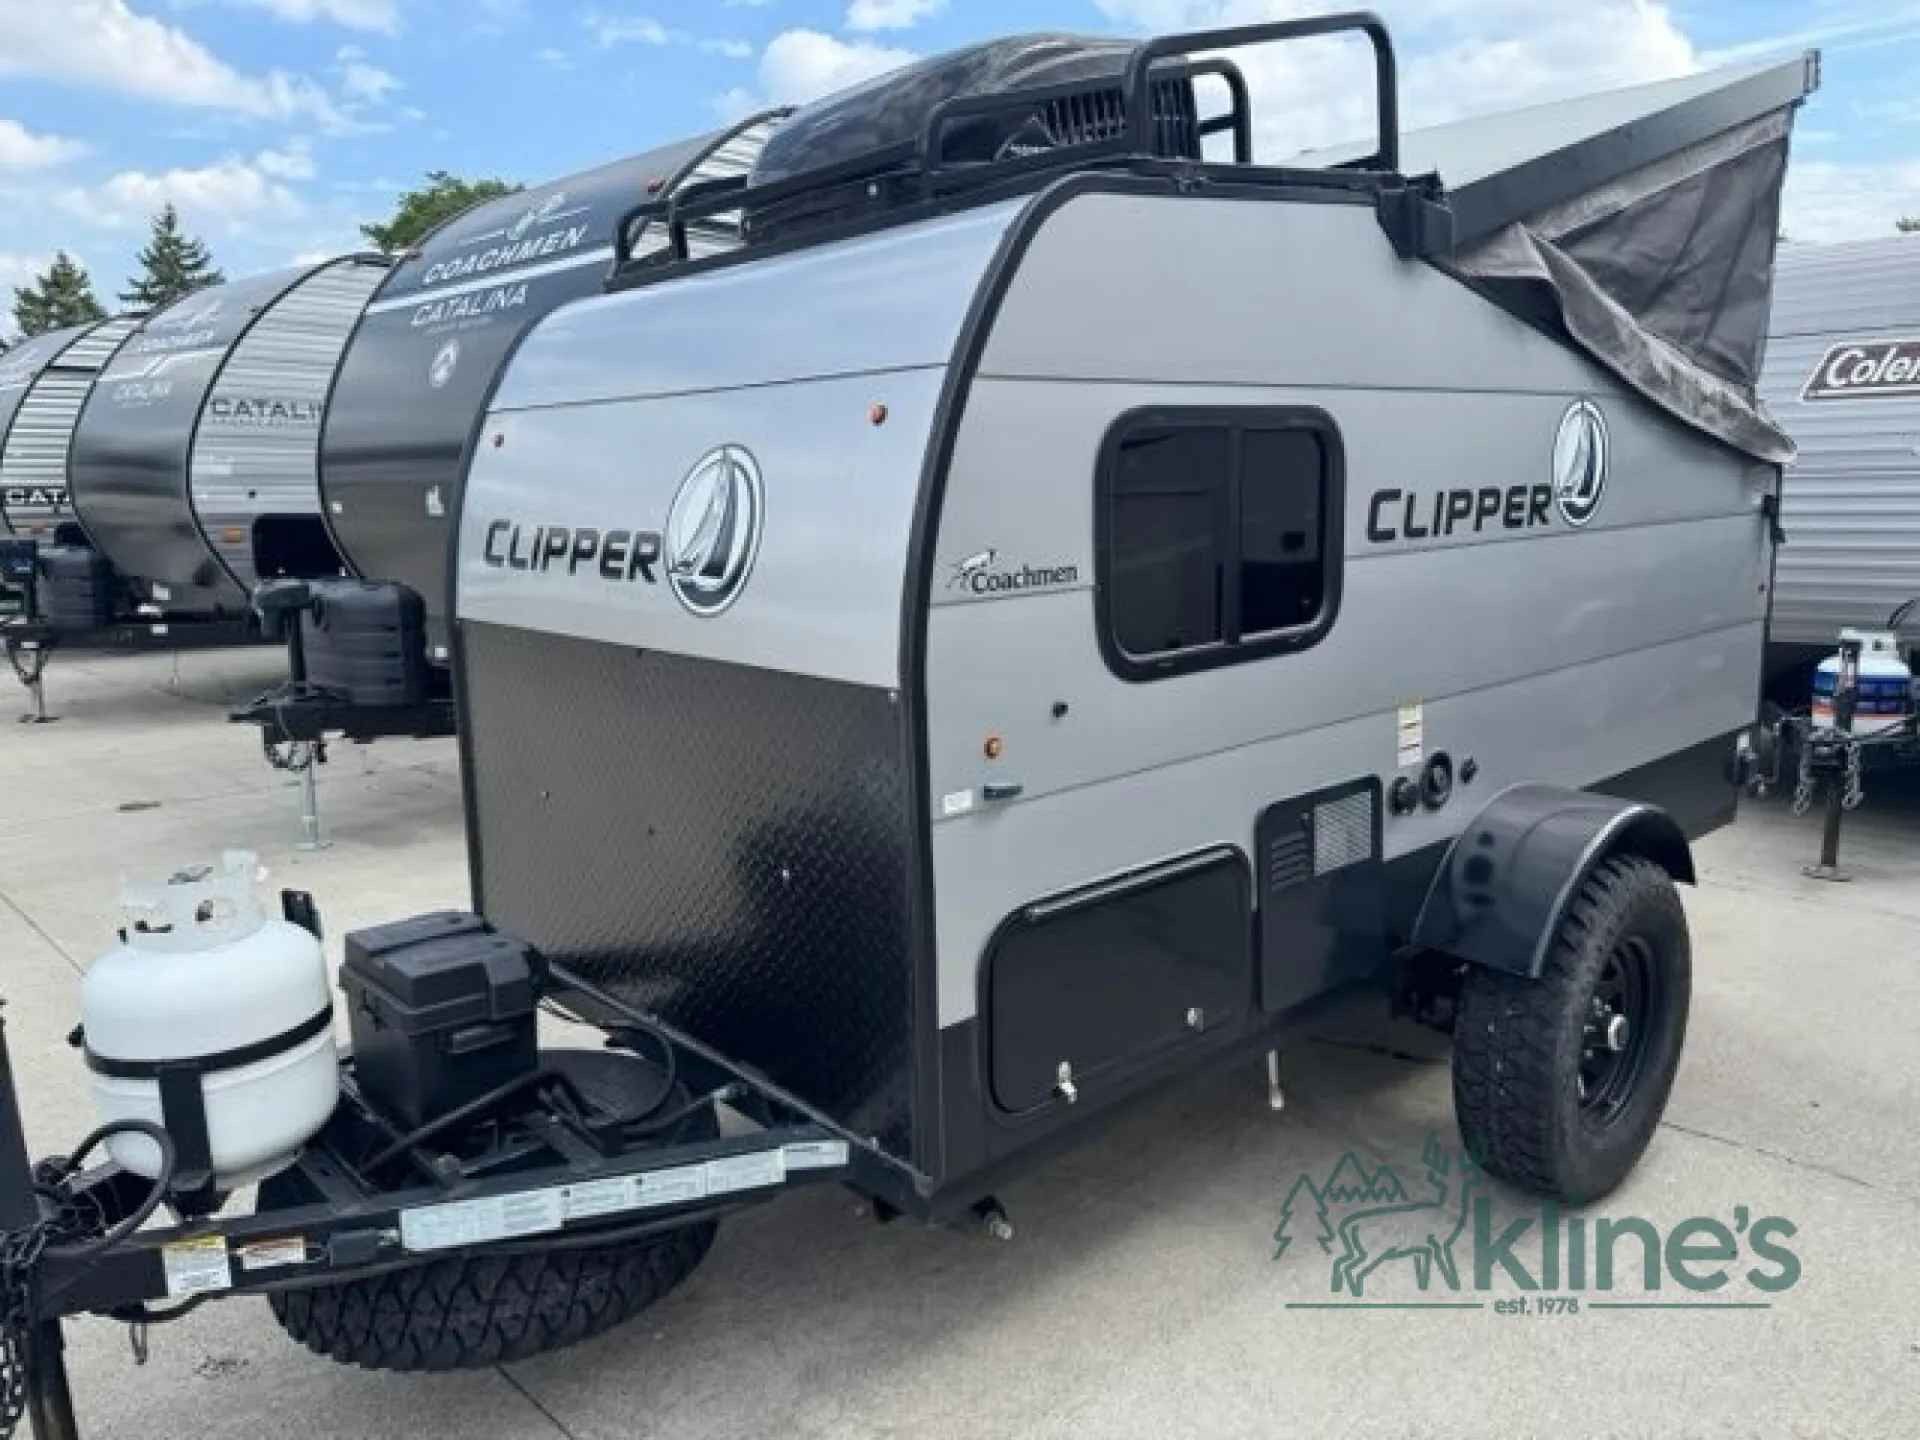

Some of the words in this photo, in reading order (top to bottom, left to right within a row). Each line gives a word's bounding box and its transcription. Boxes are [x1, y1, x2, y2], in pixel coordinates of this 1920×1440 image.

[422, 223, 588, 283] COACHMEN
[410, 285, 528, 326] CATALINA
[1366, 485, 1551, 542] CLIPPER
[484, 518, 664, 584] CLIPPER
[971, 563, 1078, 594] Coachmen
